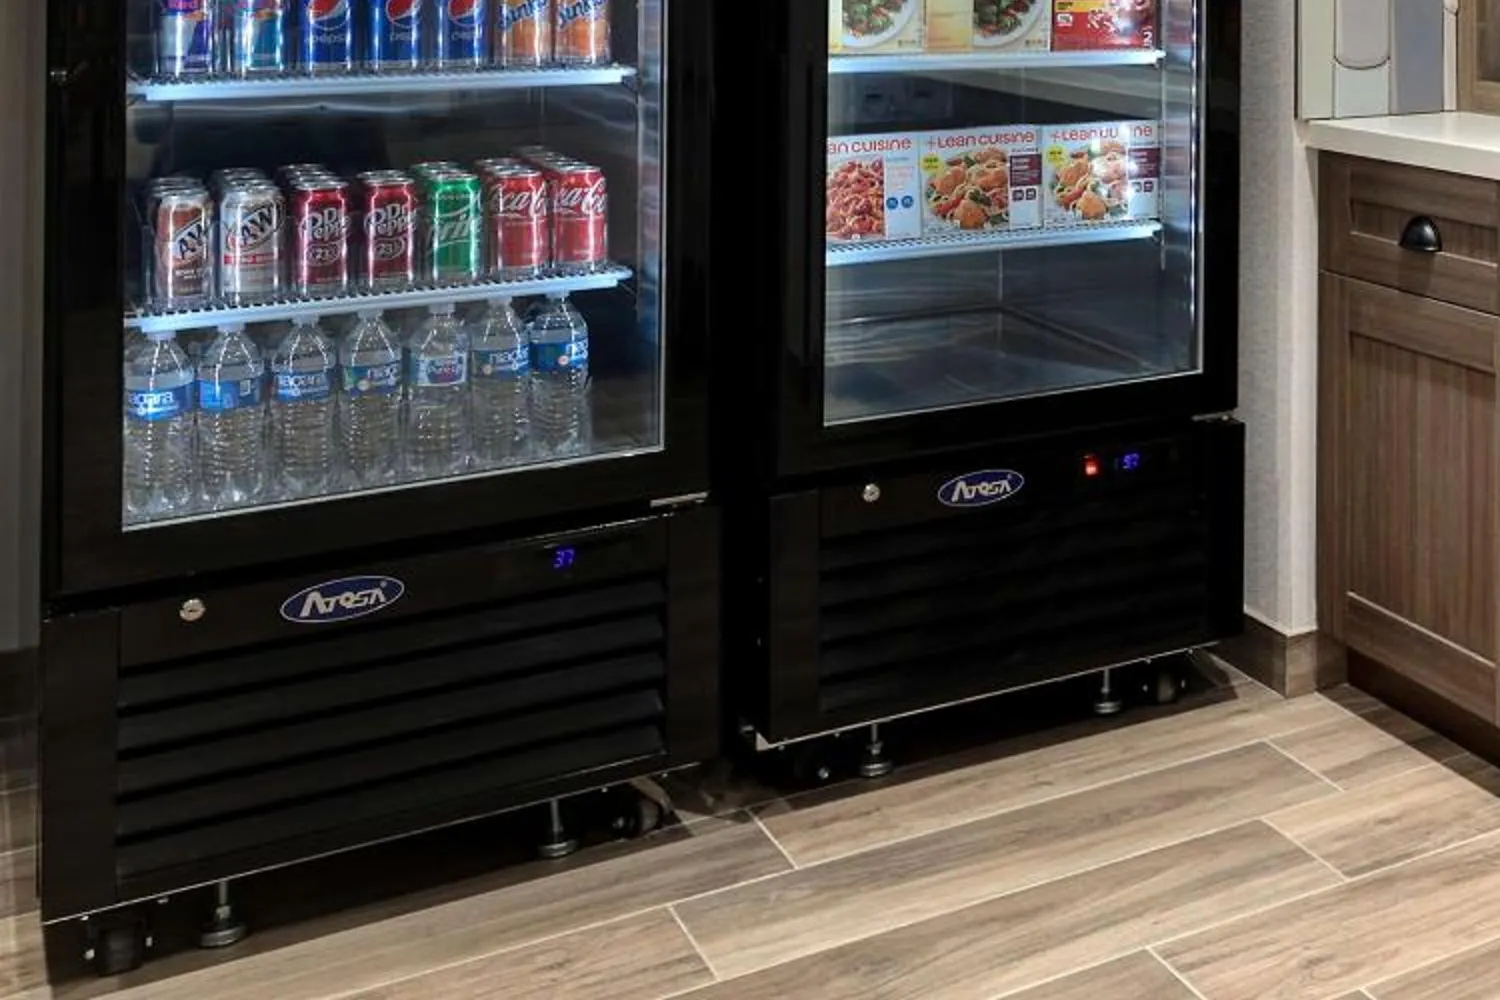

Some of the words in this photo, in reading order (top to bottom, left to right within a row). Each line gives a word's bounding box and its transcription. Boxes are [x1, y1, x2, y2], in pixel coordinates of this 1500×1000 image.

[852, 137, 912, 153] cuisine
[937, 134, 977, 149] Lean
[977, 130, 1037, 146] cuisine
